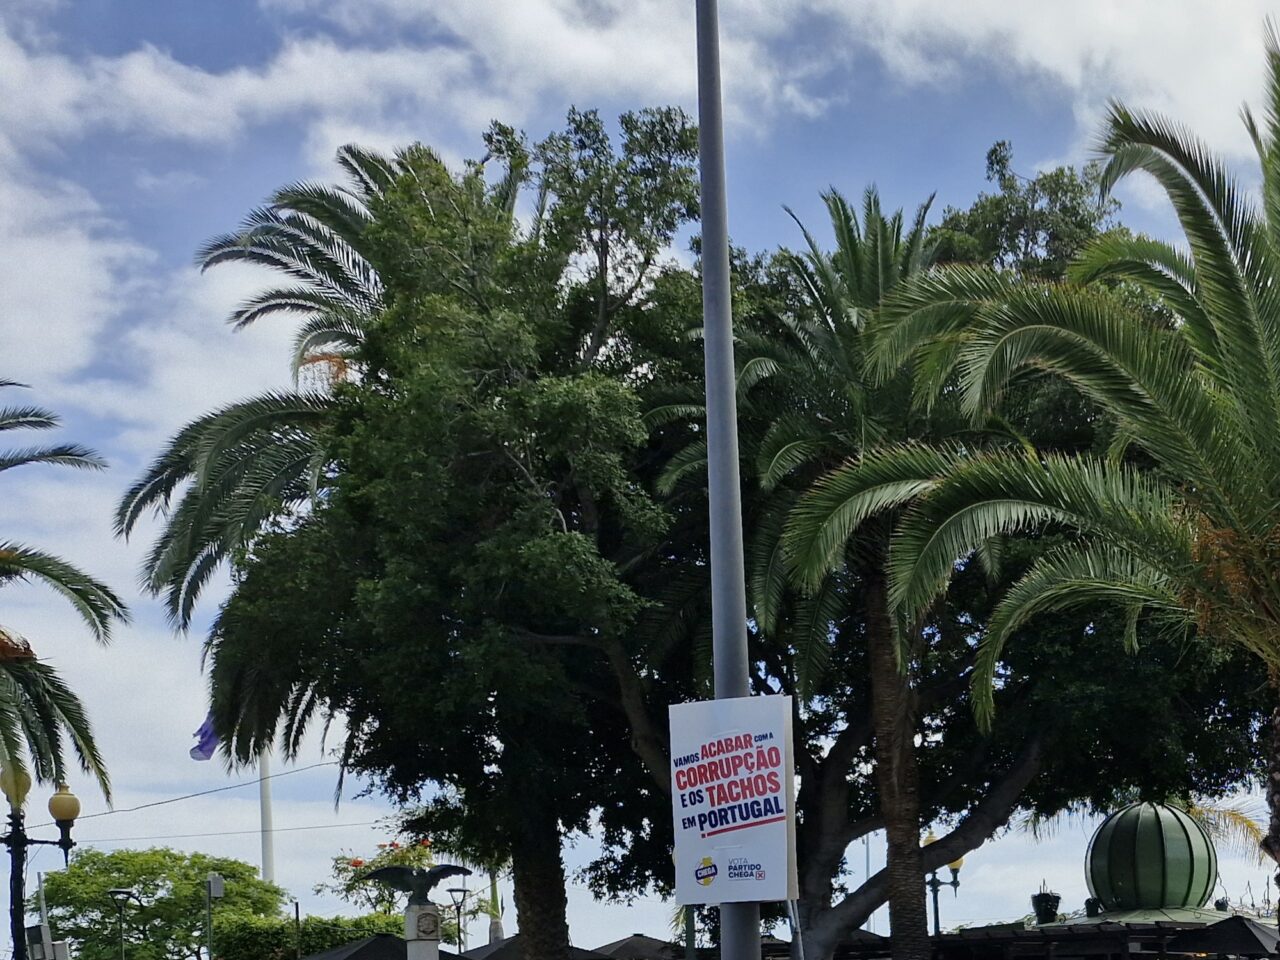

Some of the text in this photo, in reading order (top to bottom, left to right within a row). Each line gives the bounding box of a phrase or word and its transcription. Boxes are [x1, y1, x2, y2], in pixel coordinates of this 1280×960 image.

[673, 753, 700, 767] VAMOS
[701, 733, 753, 760] ACABAR
[754, 733, 768, 742] COM
[675, 745, 781, 790] CORRUPÇÃO
[680, 771, 781, 808] E OS TACHOS
[682, 796, 784, 831] EM PORTUGAL
[728, 857, 749, 865] VOTA
[728, 863, 762, 872] PARTIDO
